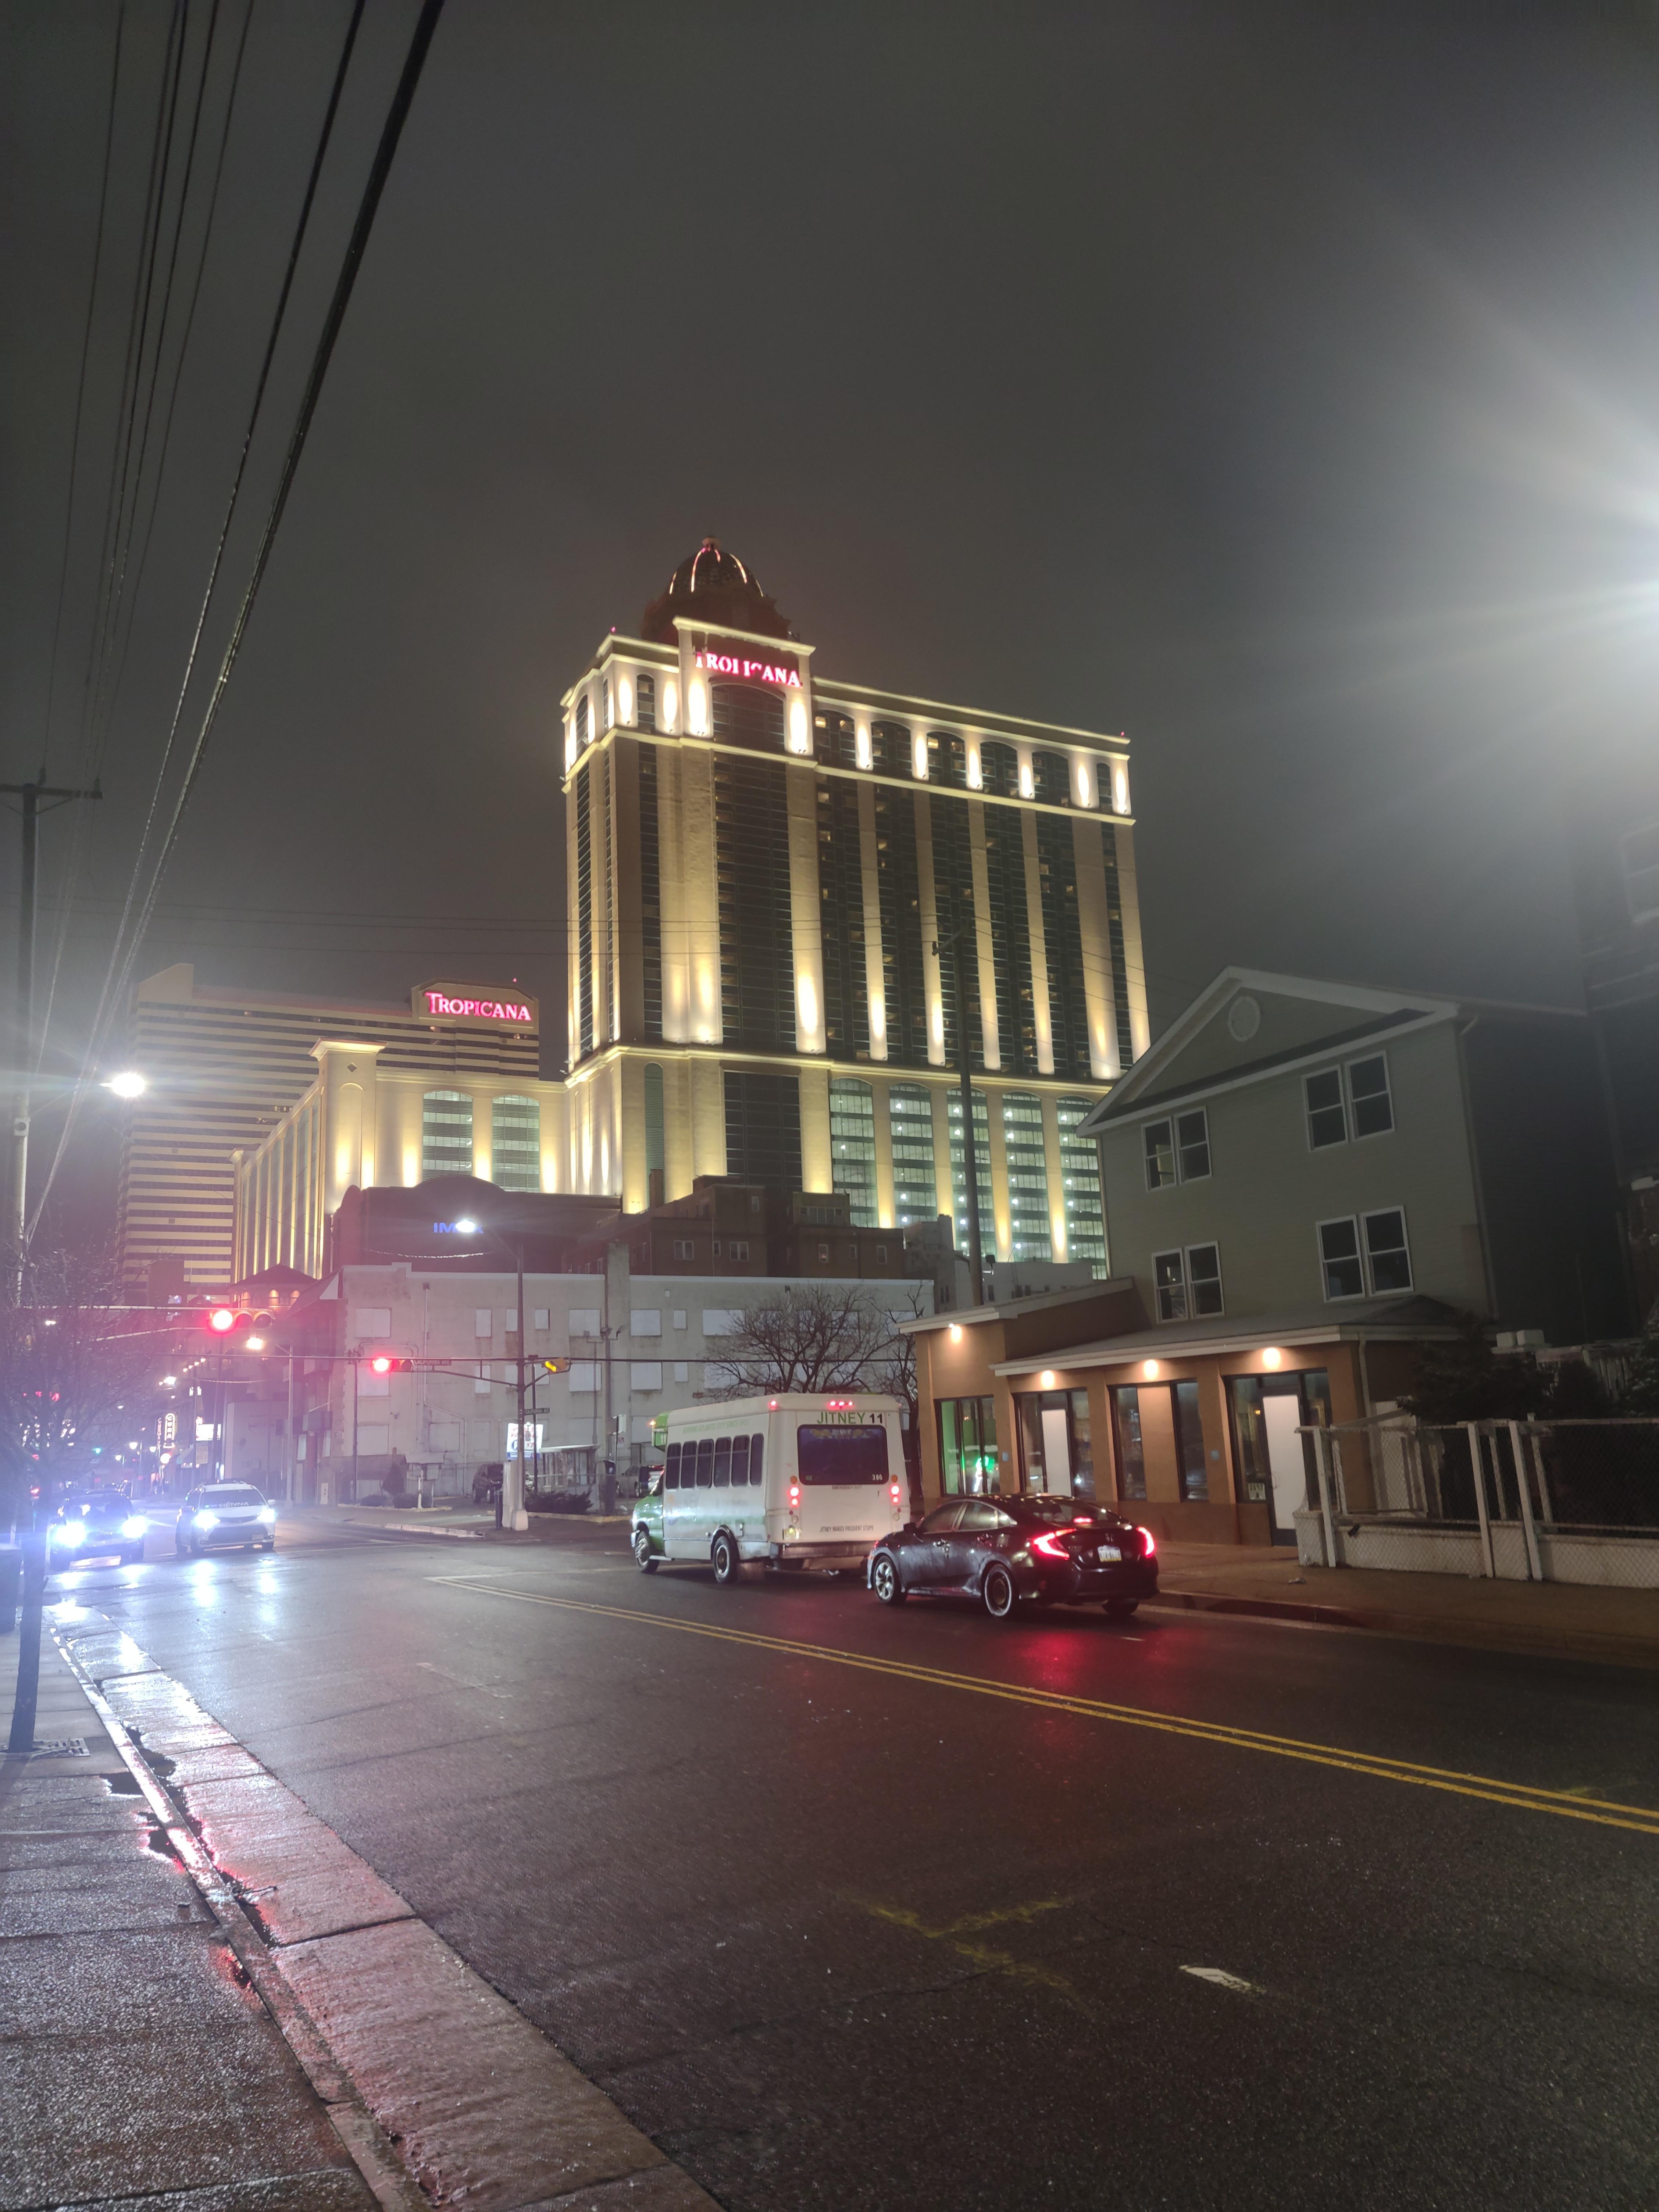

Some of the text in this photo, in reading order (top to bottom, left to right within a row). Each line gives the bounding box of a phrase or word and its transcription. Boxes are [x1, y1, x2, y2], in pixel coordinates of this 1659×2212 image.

[425, 991, 532, 1021] TROPICANA
[433, 1222, 484, 1234] IMX
[817, 1412, 882, 1424] JITNEY 11
